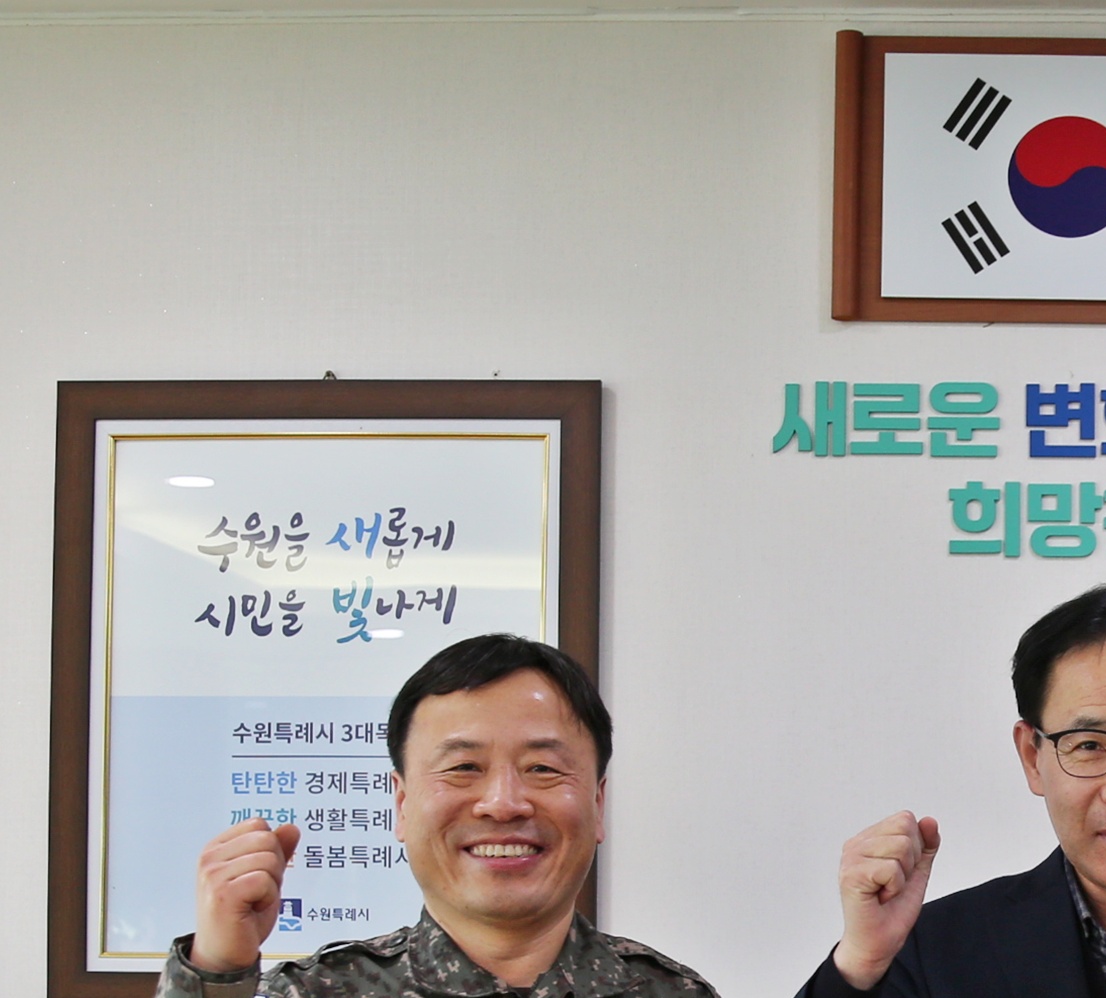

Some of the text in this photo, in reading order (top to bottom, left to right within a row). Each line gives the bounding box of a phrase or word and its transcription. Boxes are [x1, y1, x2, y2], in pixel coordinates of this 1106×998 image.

[773, 381, 1000, 458] 새로운
[197, 507, 455, 573] 수원을 새롭게
[194, 575, 457, 643] 시민을 빛나게
[232, 722, 334, 744] 수원특례시
[231, 771, 298, 795] 탄탄한
[307, 907, 370, 921] 수원특례시
